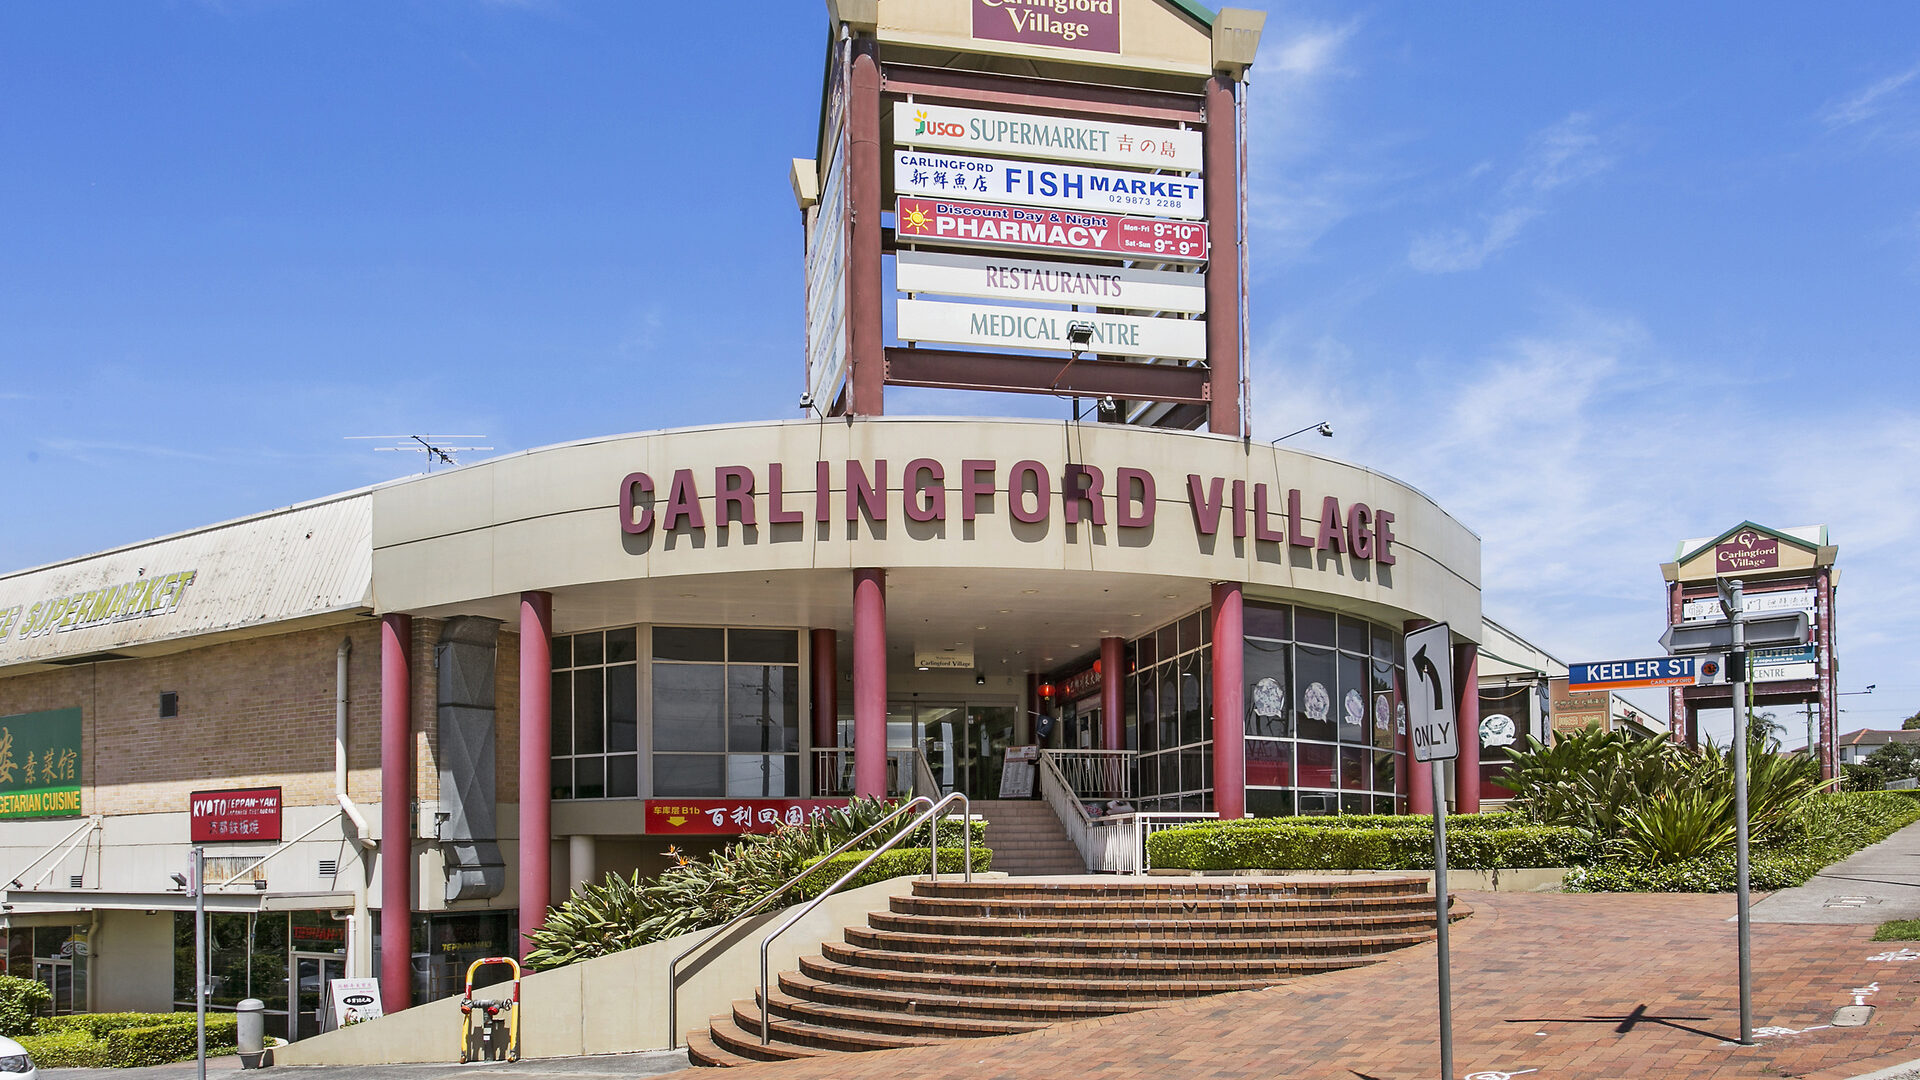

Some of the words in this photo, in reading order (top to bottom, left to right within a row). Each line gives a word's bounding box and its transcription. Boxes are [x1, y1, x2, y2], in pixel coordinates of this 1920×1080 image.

[1005, 7, 1090, 41] Village
[970, 118, 1110, 152] SUPERMARKET
[1116, 134, 1176, 158] 吉の島
[900, 156, 994, 173] CARLINGFORD
[910, 169, 988, 192] 新鮮魚店
[1005, 168, 1084, 200] FISH
[1090, 175, 1199, 200] MARKET
[1125, 196, 1151, 206] 9873
[1156, 199, 1182, 208] 2288
[936, 204, 1009, 219] Discount
[1013, 210, 1043, 223] Day
[1049, 213, 1061, 223] &
[1066, 214, 1108, 228] Night
[936, 216, 1108, 248] PHARMACY
[986, 266, 1121, 298] RESTAURANTS
[970, 313, 1060, 341] MEDICAL
[1066, 320, 1139, 346] CNTRE
[619, 458, 1157, 534] CARLINGFORD
[1187, 474, 1396, 565] VILLAGE
[1718, 546, 1776, 561] Carlingford
[1730, 558, 1766, 568] Village
[20, 570, 197, 637] SUPERMARKET
[1587, 660, 1660, 681] KEELER
[1668, 658, 1692, 676] ST
[1753, 668, 1785, 679] CENTRE
[1650, 678, 1692, 686] CARLINGFORD
[1414, 722, 1450, 747] ONLY
[42, 791, 80, 811] CUISINE
[193, 799, 227, 817] KYOTO
[227, 797, 277, 808] TEPPAN-YAKI
[681, 806, 700, 814] B1b
